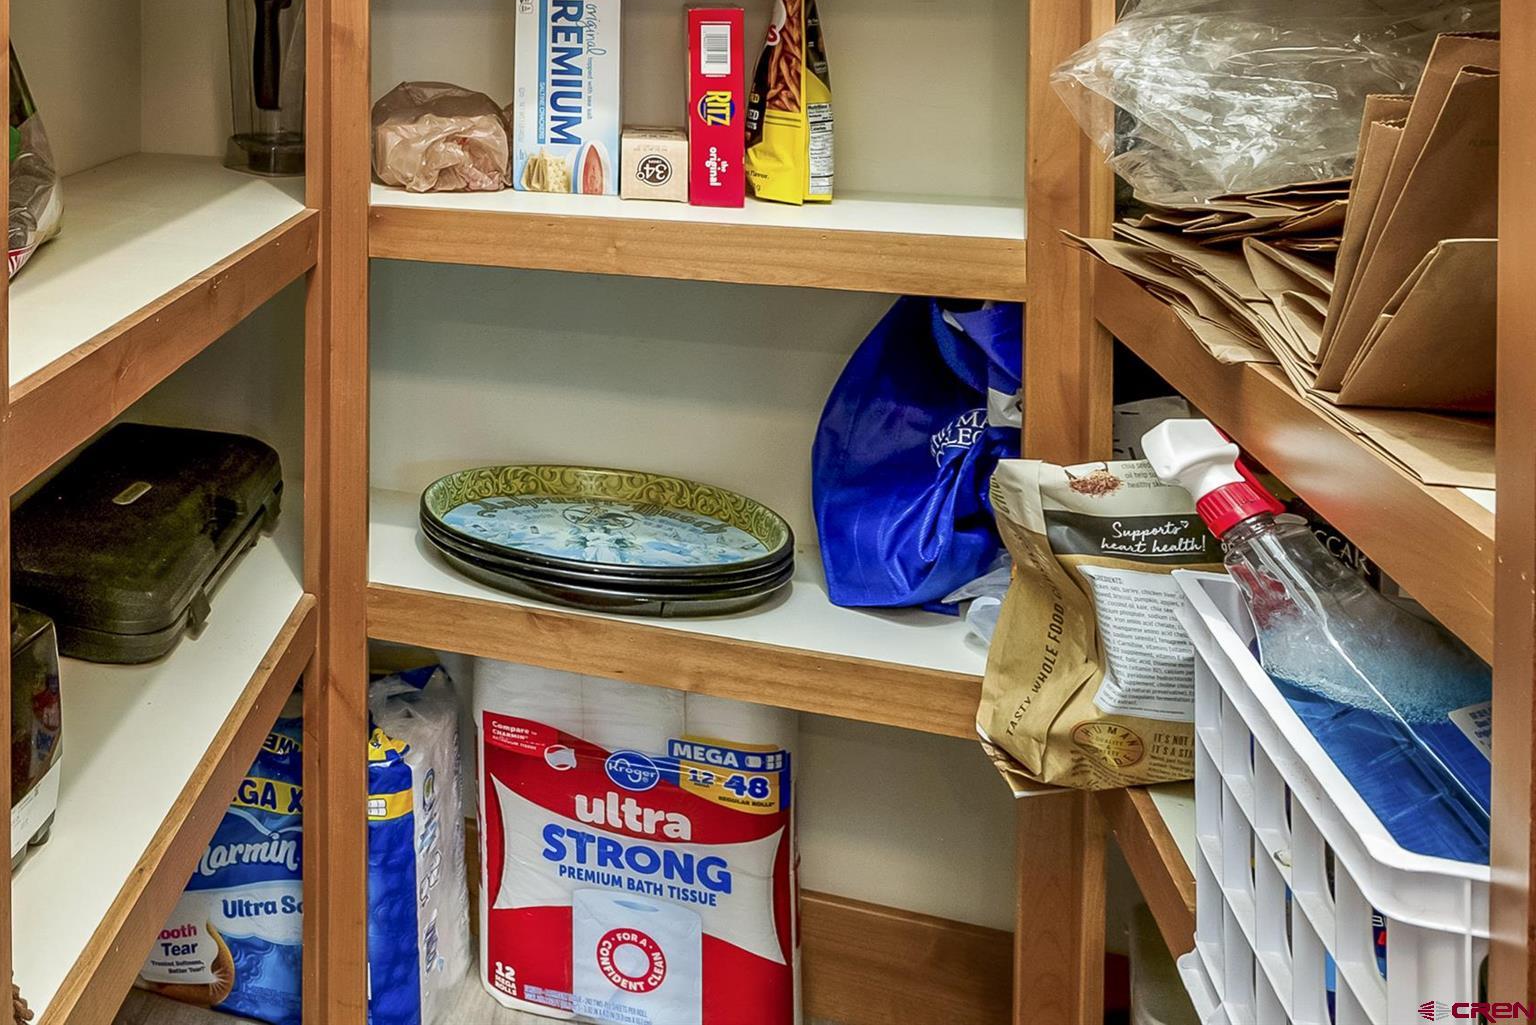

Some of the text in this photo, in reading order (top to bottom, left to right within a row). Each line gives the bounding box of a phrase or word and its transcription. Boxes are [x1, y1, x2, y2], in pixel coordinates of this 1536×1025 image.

[577, 3, 607, 56] original
[705, 91, 732, 126] RITZ
[705, 146, 722, 186] original
[720, 160, 729, 173] the
[1101, 534, 1206, 553] heart health!
[1112, 521, 1181, 541] Supports
[1005, 605, 1065, 737] TASTY WHOLE FOOD
[492, 720, 530, 735] Compare
[673, 742, 739, 767] MEGA
[608, 758, 657, 783] Kroger
[723, 773, 770, 799] 48
[718, 796, 750, 806] REGULAR
[574, 792, 692, 840] ultra
[542, 823, 732, 894] STRONG
[559, 865, 718, 907] PREMIUM BATH TISSUE
[222, 898, 277, 919] Ultra
[161, 941, 198, 957] Tear
[616, 932, 648, 946] FOR A
[495, 961, 516, 982] 12
[600, 940, 645, 992] CONFIDENT
[648, 952, 665, 986] CLEAN
[495, 983, 518, 997] ROLLS
